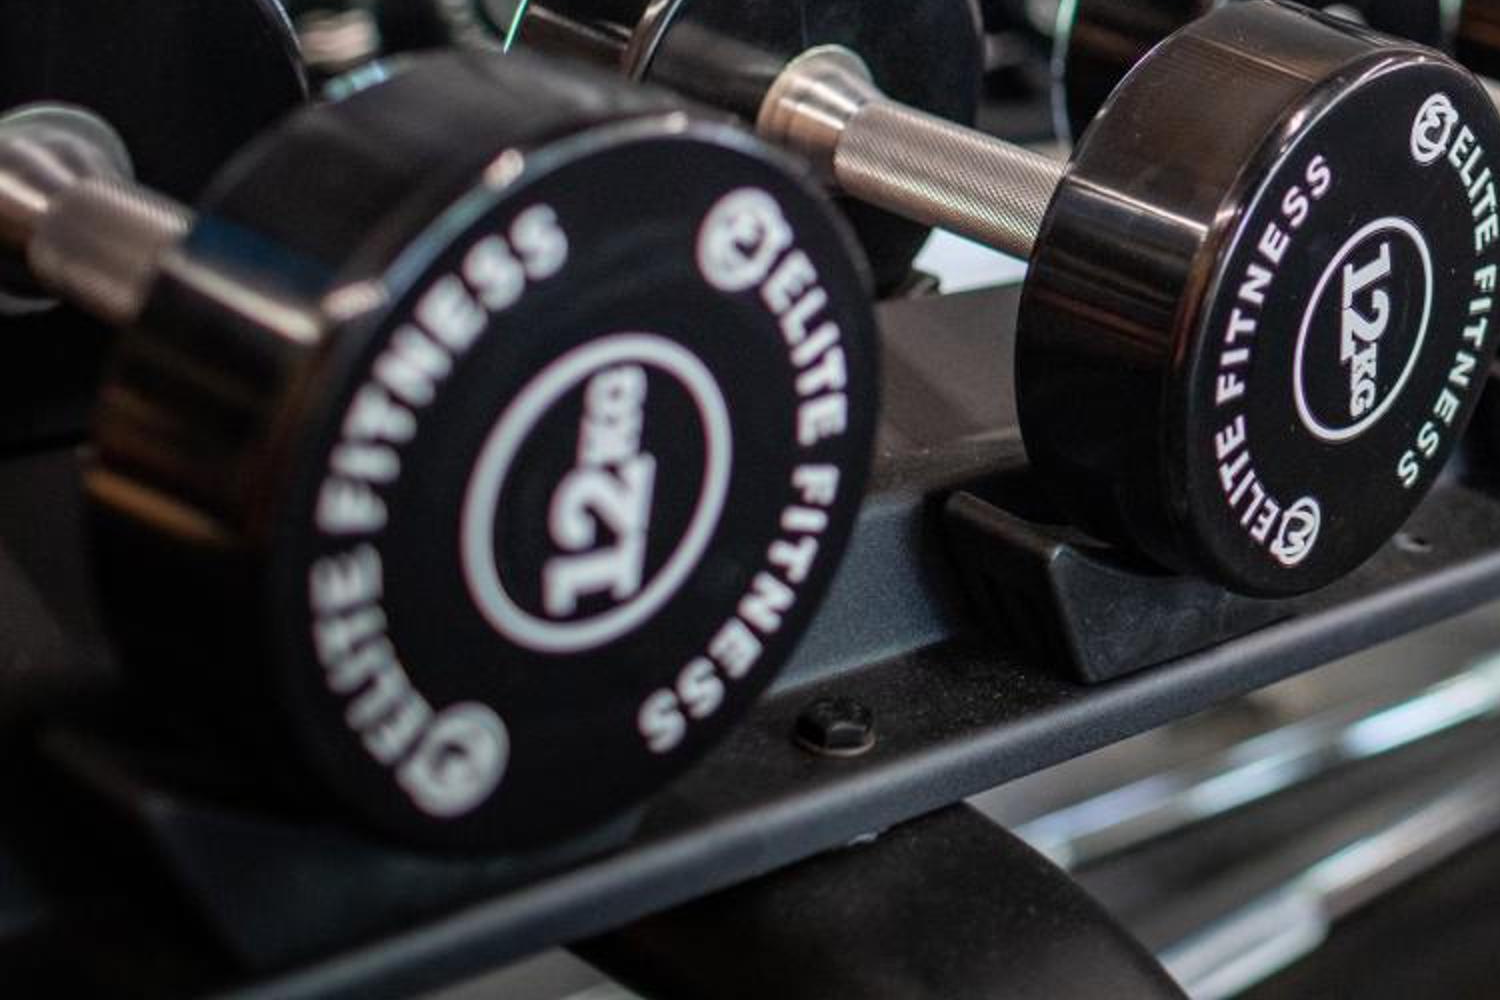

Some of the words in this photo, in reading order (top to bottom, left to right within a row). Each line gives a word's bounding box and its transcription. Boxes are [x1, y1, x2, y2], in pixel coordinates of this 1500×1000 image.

[1216, 154, 1334, 405] FITNESS
[1448, 124, 1499, 254] ELITE
[315, 202, 569, 535] FITNESS
[761, 248, 850, 446] ELITE
[1340, 240, 1393, 418] 12KG
[1397, 263, 1498, 489] FITNESS
[1216, 413, 1280, 544] ELITE
[308, 541, 434, 766] ELITE
[637, 463, 842, 754] FITNESS
